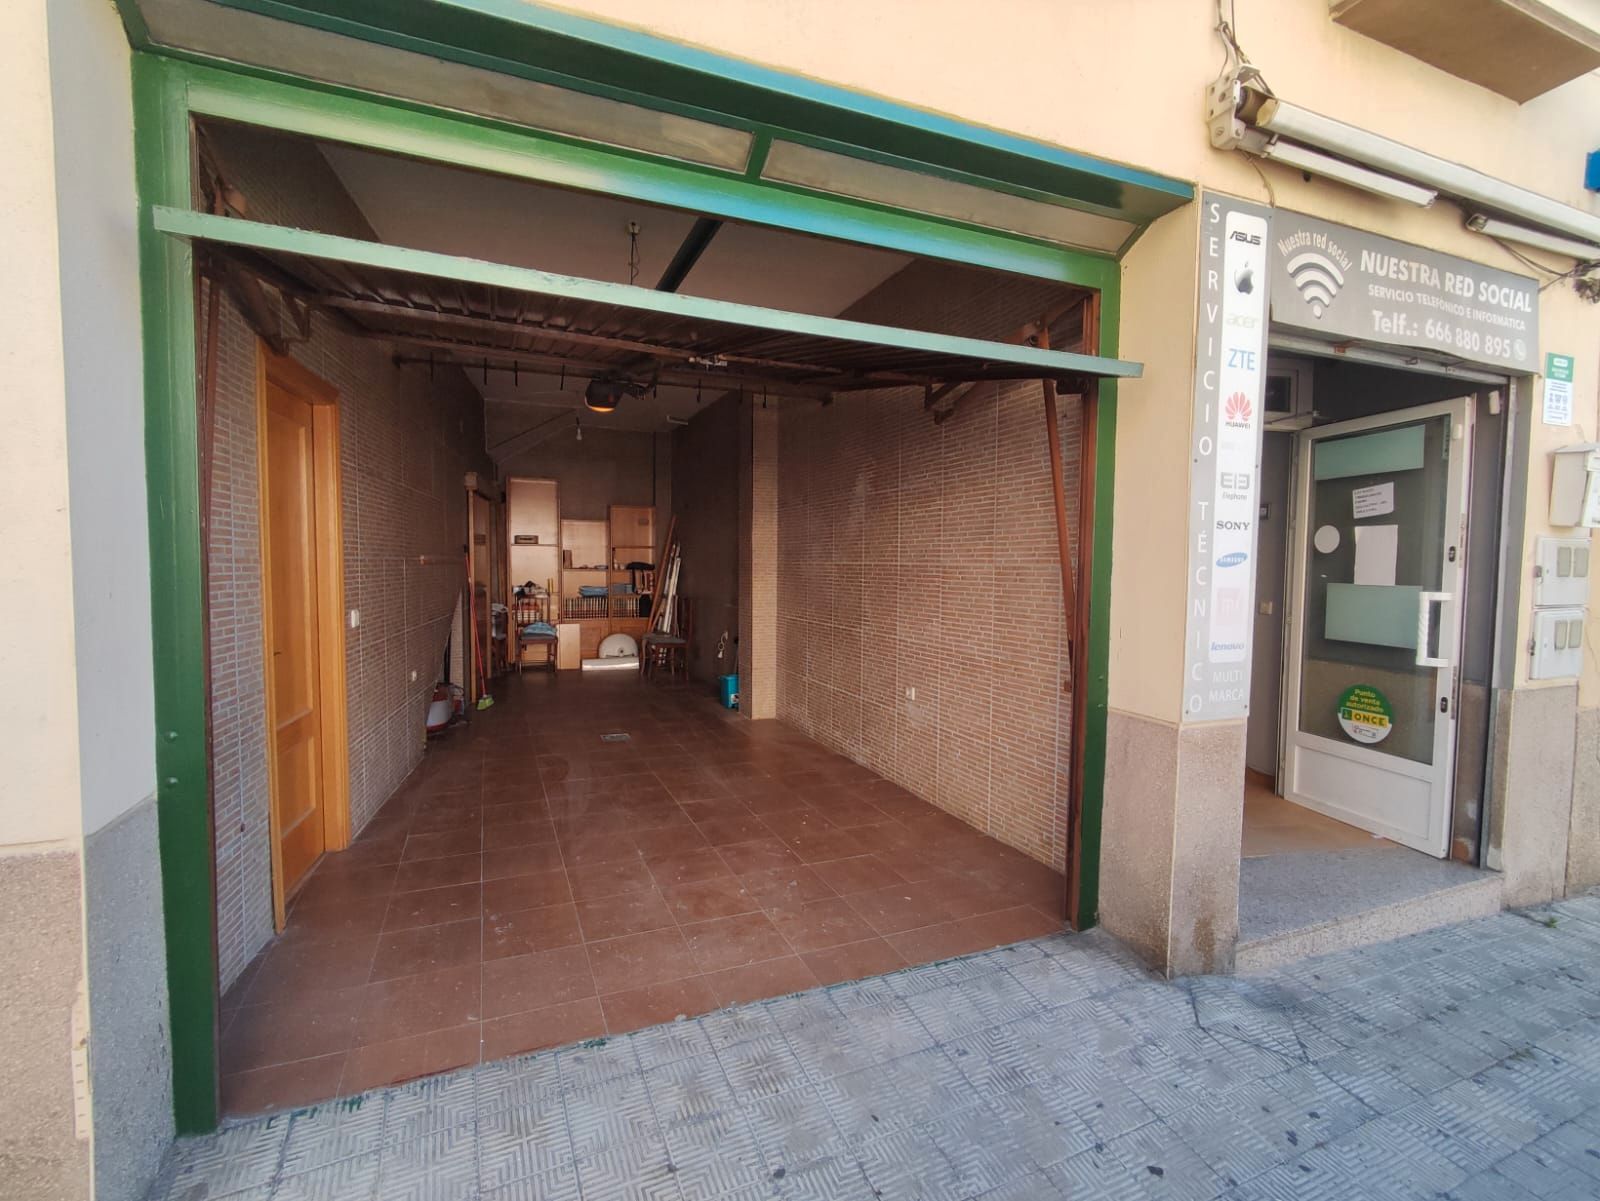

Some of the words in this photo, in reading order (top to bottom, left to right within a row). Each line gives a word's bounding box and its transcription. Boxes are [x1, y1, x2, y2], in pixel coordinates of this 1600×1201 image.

[1230, 231, 1261, 245] ASUS
[1277, 228, 1311, 257] Nuestra
[1312, 233, 1327, 249] red
[1327, 240, 1353, 272] social
[1360, 250, 1441, 290] NUESTRA
[1444, 271, 1474, 298] RED
[1478, 281, 1532, 313] SOCIAL
[1368, 284, 1414, 303] SERVICIO
[1465, 308, 1472, 319] E
[1198, 203, 1220, 456] SERVICIO
[1372, 310, 1418, 337] Telf.:
[1425, 318, 1452, 344] 666
[1455, 327, 1480, 352] 880
[1484, 335, 1511, 358] 895
[1228, 348, 1256, 371] ZTE
[1225, 421, 1251, 430] HUAWEI
[1216, 521, 1250, 531] SONY
[1190, 501, 1209, 713] TÉCNICO
[1211, 641, 1245, 652] lenovo
[1213, 671, 1244, 682] MULTI
[1209, 688, 1244, 704] MARCA
[1354, 713, 1386, 727] ONCE
